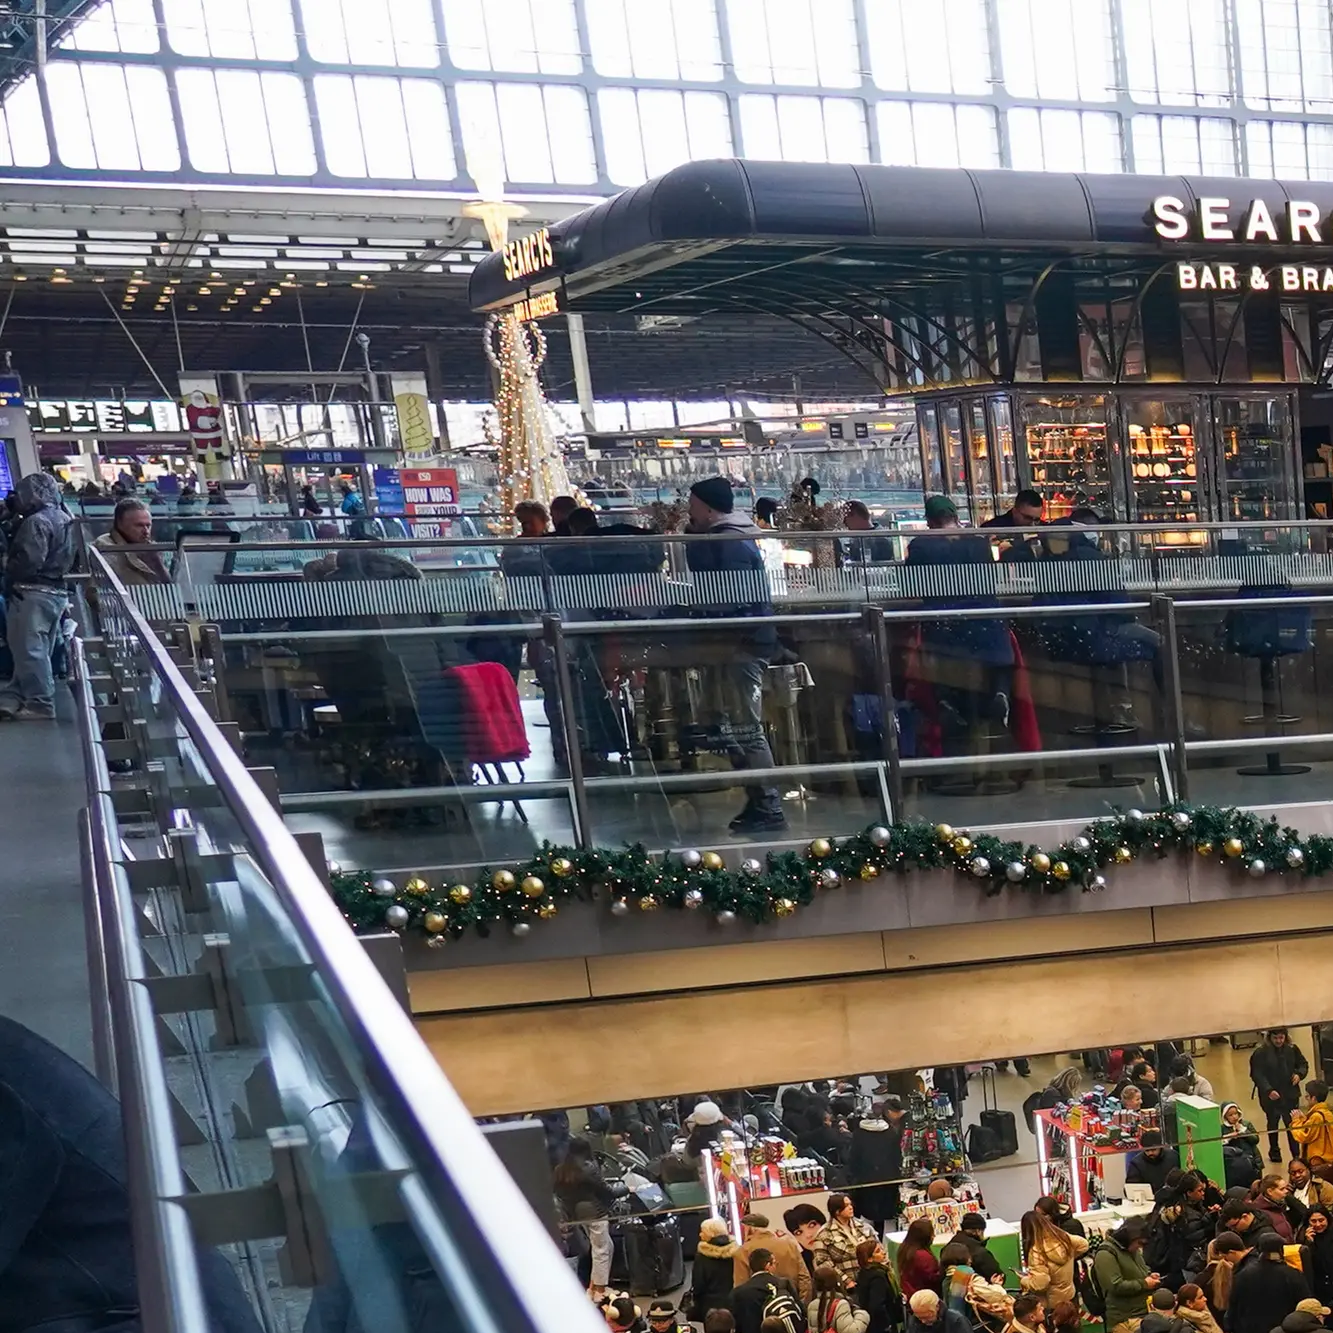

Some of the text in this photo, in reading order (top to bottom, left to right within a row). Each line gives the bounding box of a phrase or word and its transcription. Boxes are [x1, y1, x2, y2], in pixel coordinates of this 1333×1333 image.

[502, 227, 553, 281] SEARCYS
[1178, 264, 1237, 290] BAR
[1250, 265, 1270, 291] &
[306, 451, 321, 461] Lift
[405, 486, 452, 503] HOW WAS
[410, 524, 441, 540] VISIT?
